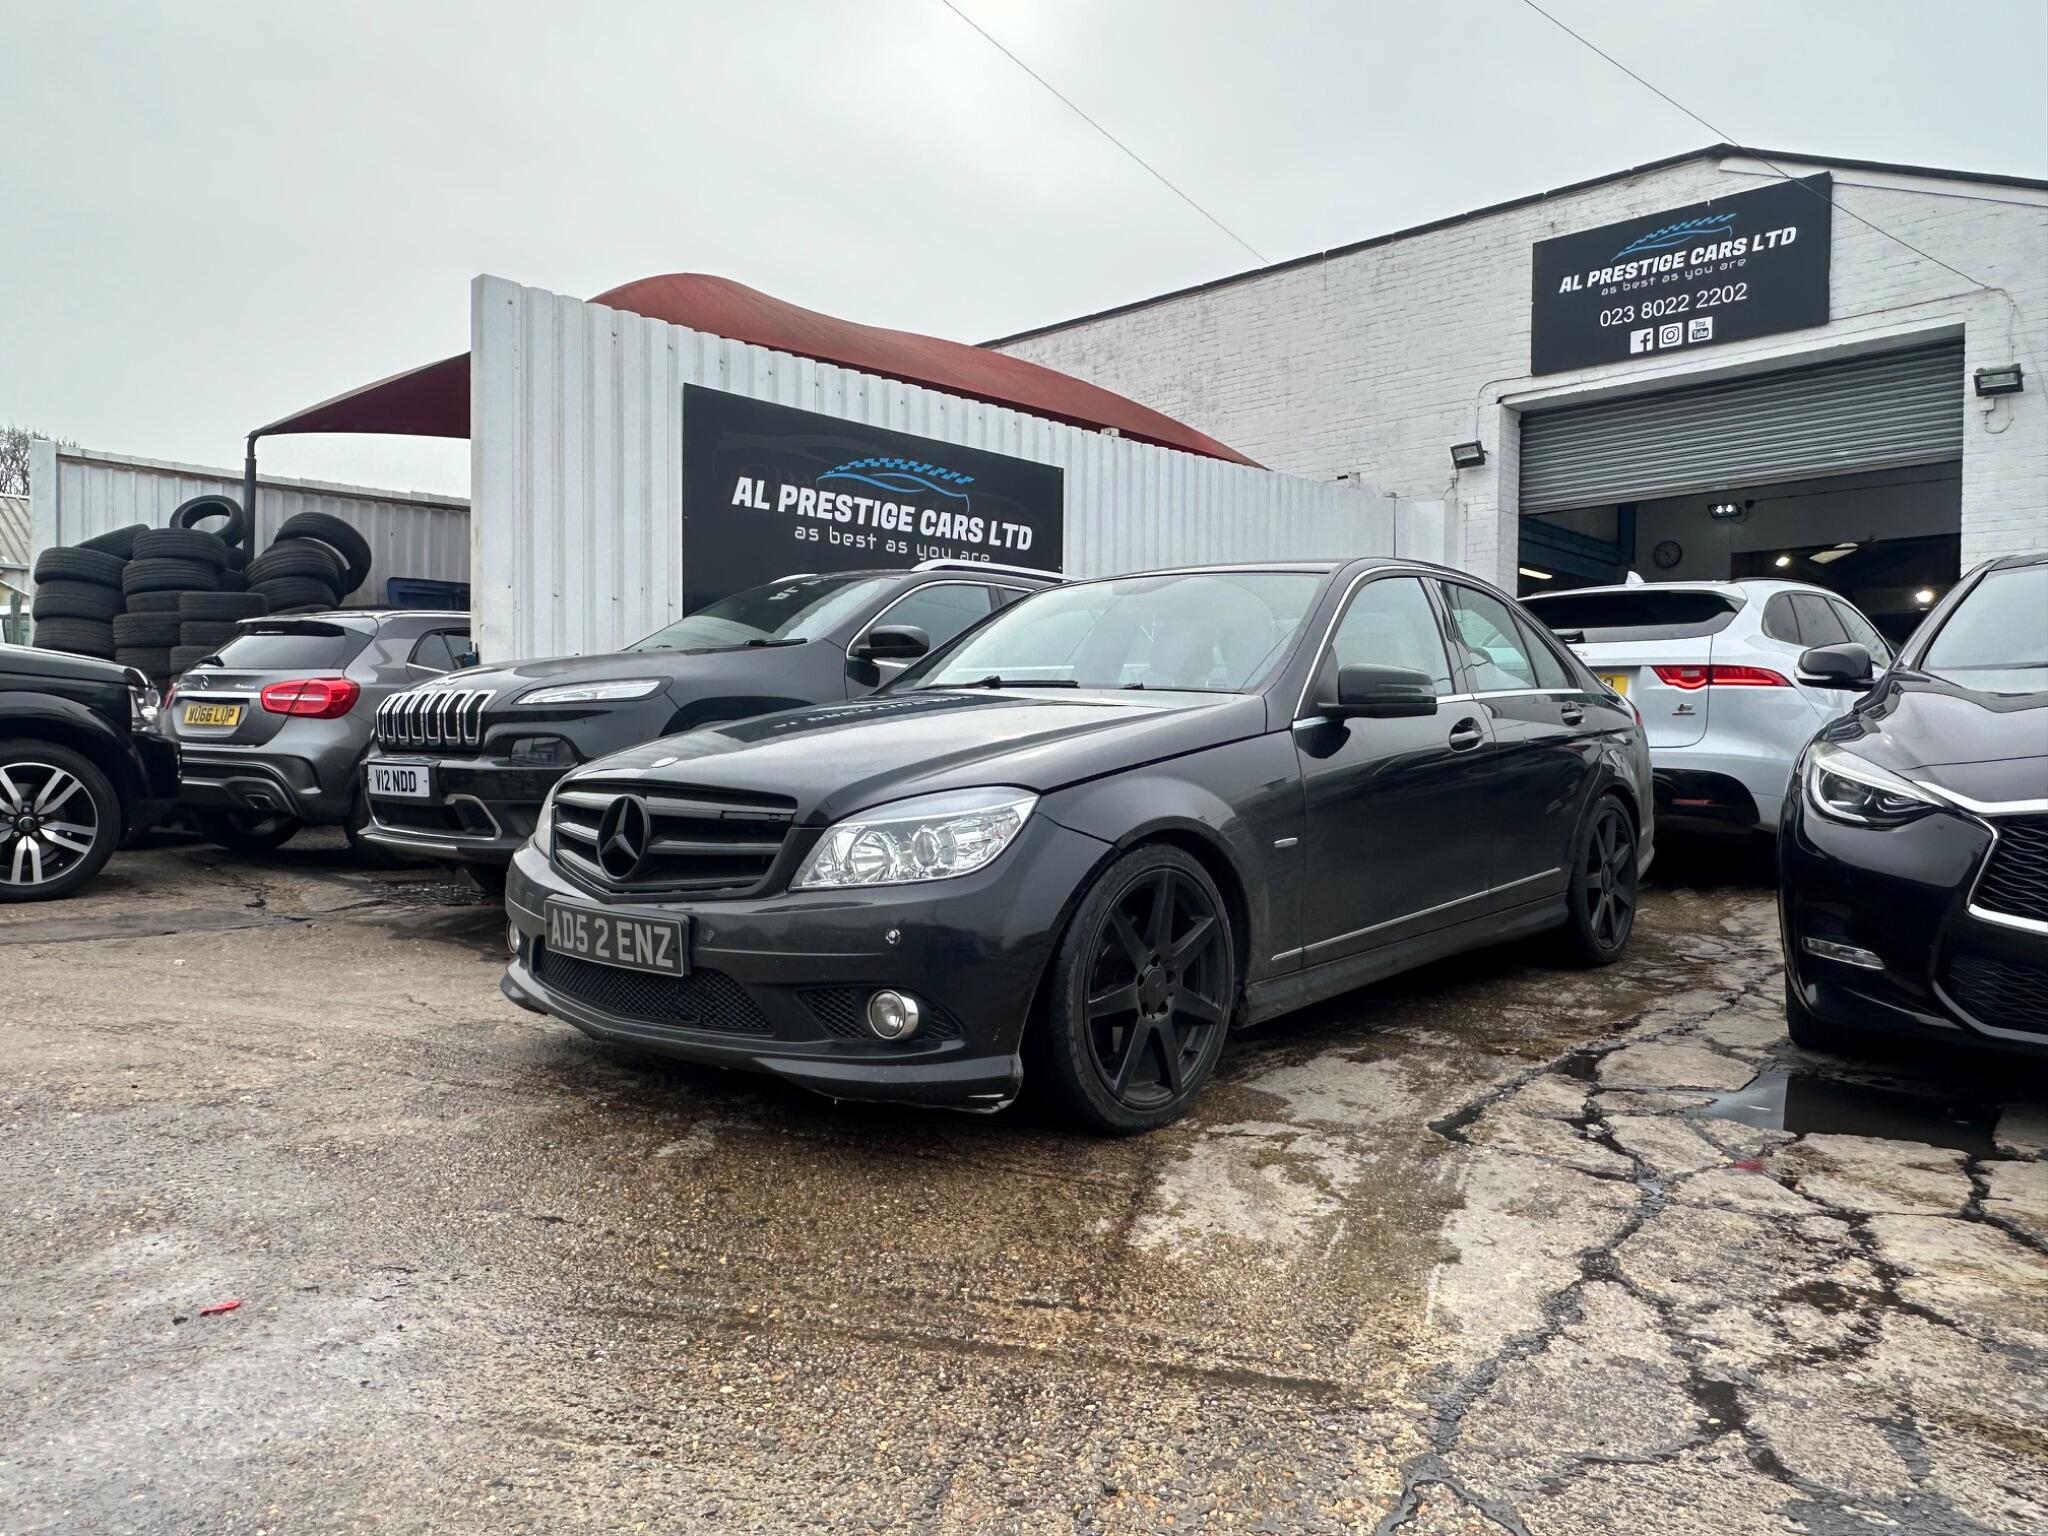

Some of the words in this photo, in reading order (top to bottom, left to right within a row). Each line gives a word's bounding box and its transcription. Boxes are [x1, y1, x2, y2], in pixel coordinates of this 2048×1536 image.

[1558, 273, 1583, 294] AL
[1587, 250, 1686, 288] PRESTIGE
[1690, 238, 1747, 266] CARS
[1751, 226, 1797, 252] LTD
[1601, 286, 1617, 296] as
[1622, 276, 1656, 292] best
[1661, 272, 1679, 283] as
[1685, 265, 1713, 281] you
[1719, 258, 1747, 270] are
[1600, 305, 1635, 327] 023
[1641, 294, 1690, 320] 8022
[1695, 282, 1748, 309] 2202
[731, 476, 771, 511] AL
[777, 483, 914, 533] PRESTIGE
[919, 509, 984, 544] CARS
[988, 520, 1033, 551] LTD
[794, 525, 820, 542] as
[829, 525, 878, 550] best
[885, 538, 908, 555] as
[916, 543, 952, 562] you
[960, 550, 990, 562] are
[375, 768, 391, 792] V12
[393, 769, 417, 793] NDD
[616, 920, 673, 968] ENZ
